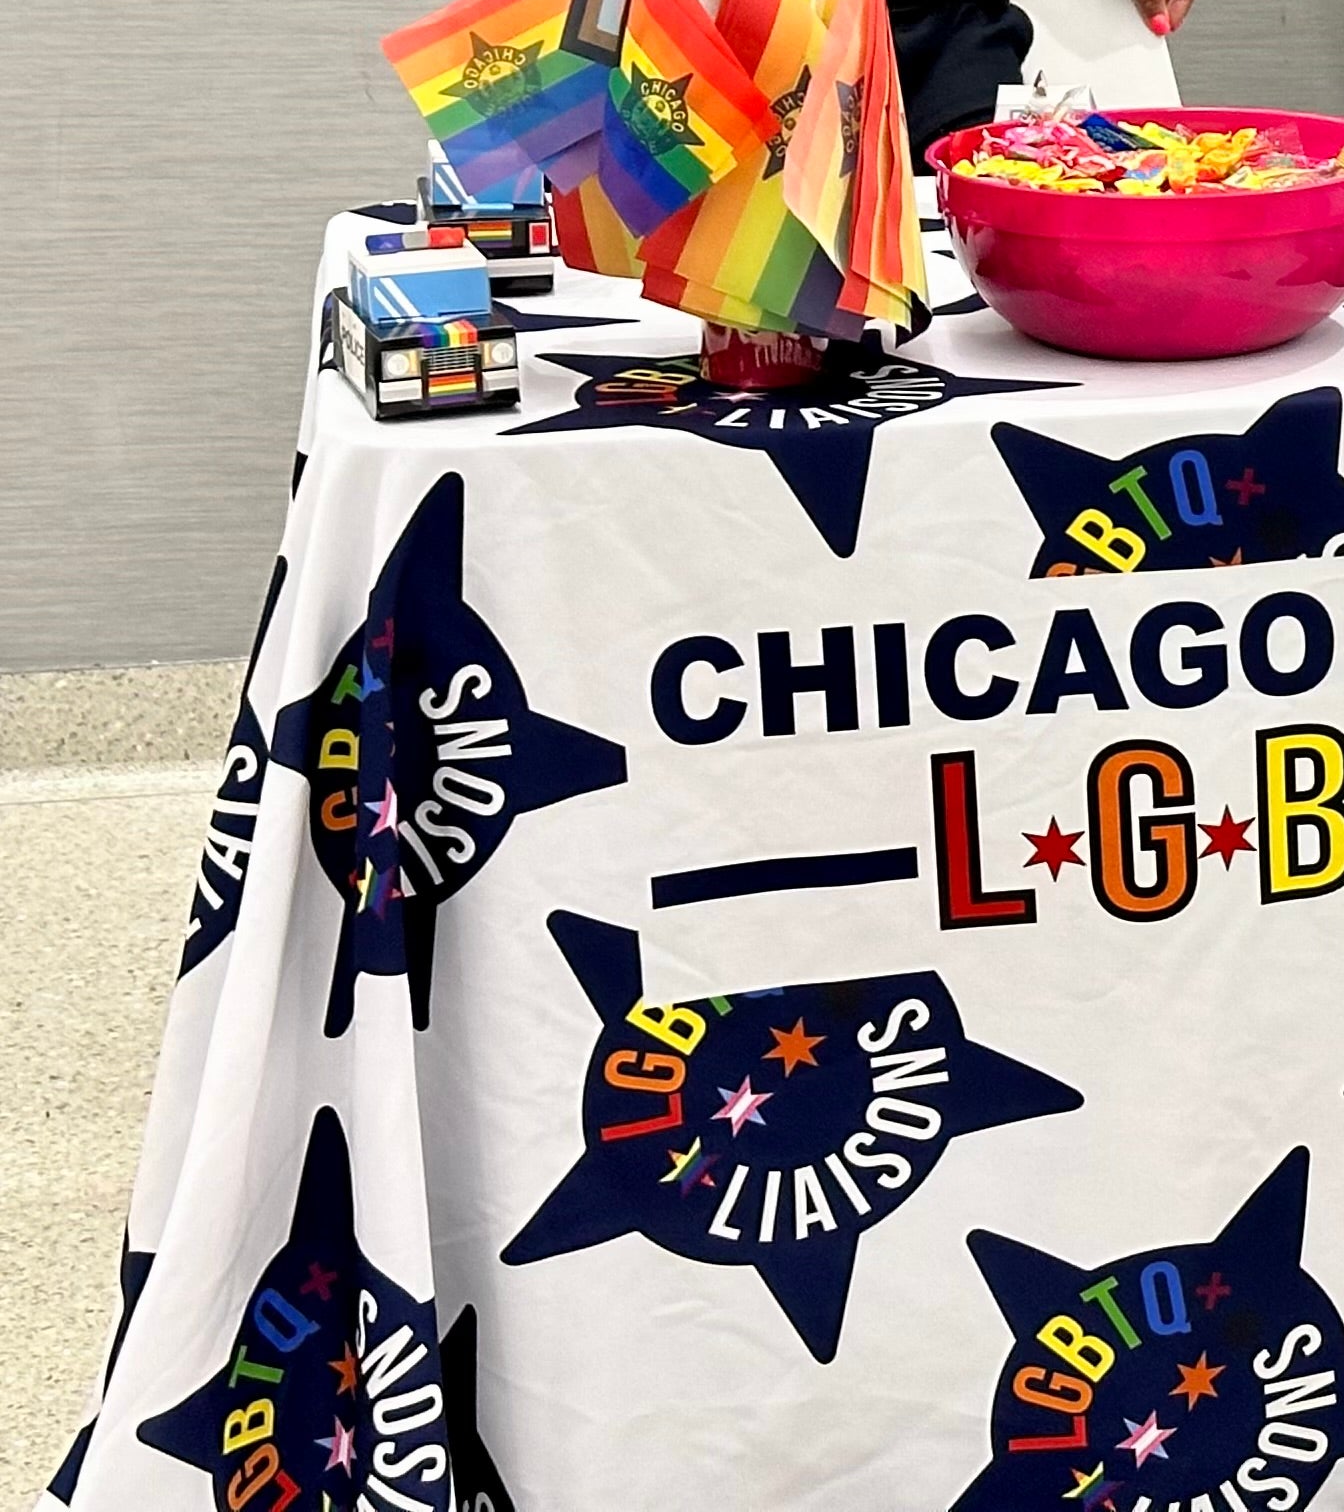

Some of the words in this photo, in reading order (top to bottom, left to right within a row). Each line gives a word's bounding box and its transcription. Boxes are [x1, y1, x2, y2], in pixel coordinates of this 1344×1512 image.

[641, 81, 686, 134] CHICAGO
[650, 590, 1336, 746] CHICAGO
[708, 998, 950, 1243] LIAISONS
[1008, 1260, 1232, 1452] LGBTQ+
